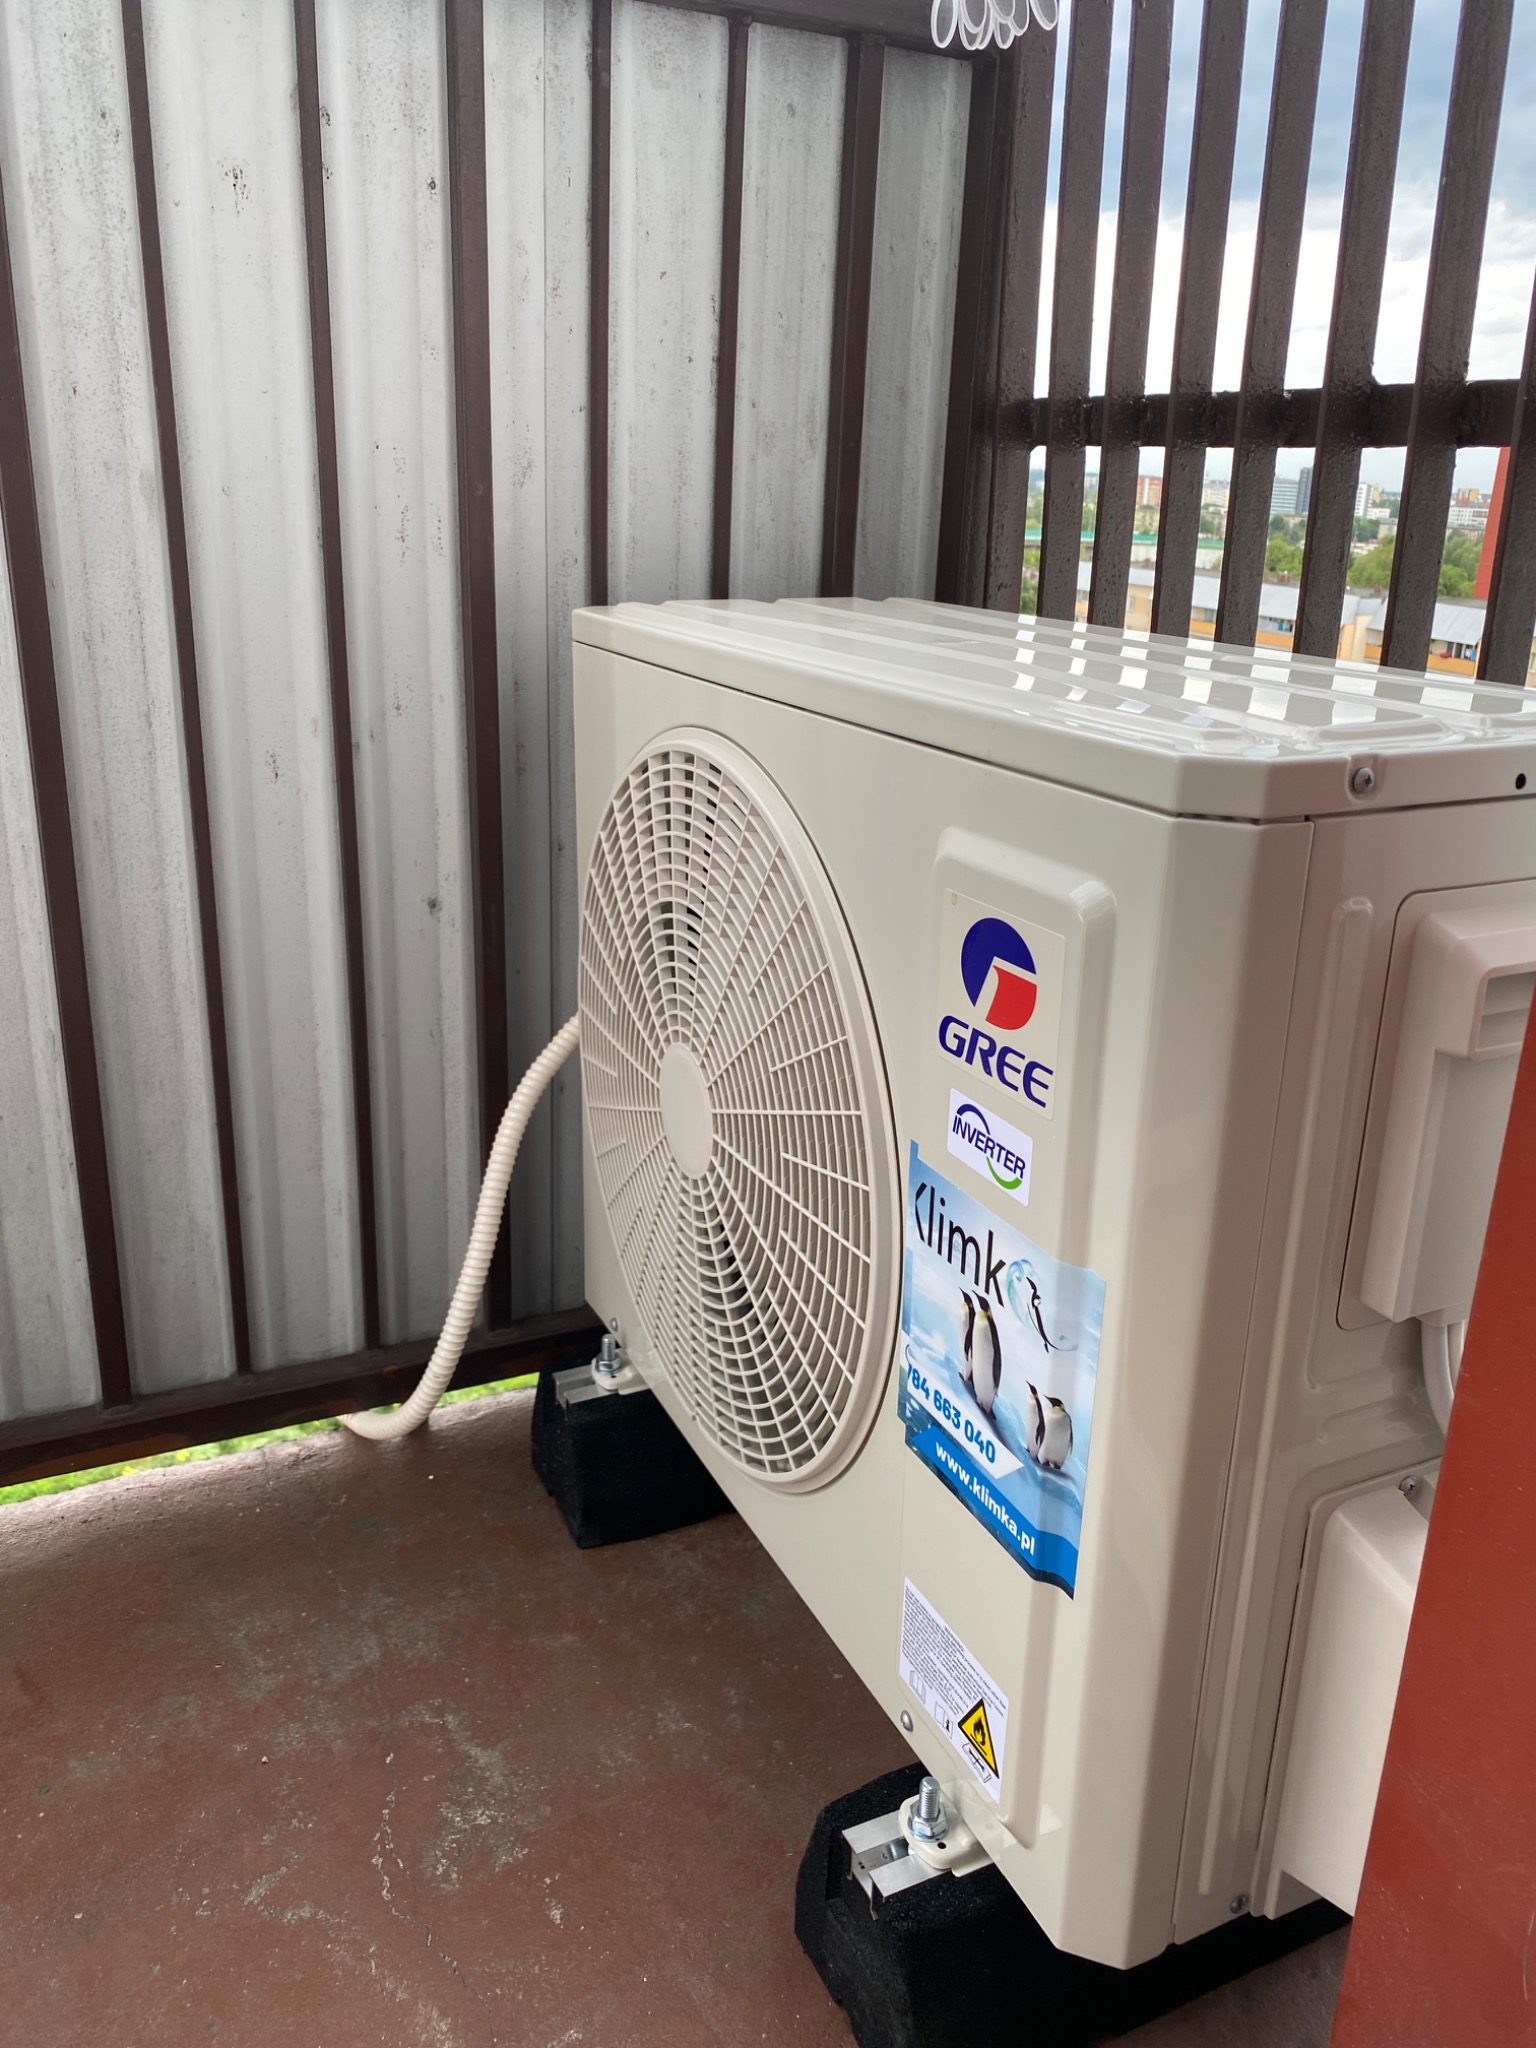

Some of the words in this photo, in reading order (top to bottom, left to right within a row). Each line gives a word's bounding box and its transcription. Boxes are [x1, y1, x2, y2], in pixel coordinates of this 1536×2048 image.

[939, 1015, 1054, 1108] GREE
[952, 1115, 1026, 1179] INVERTER
[933, 1390, 961, 1429] 663
[965, 1420, 996, 1463] 040
[936, 1442, 1036, 1556] www.klimka.pl
